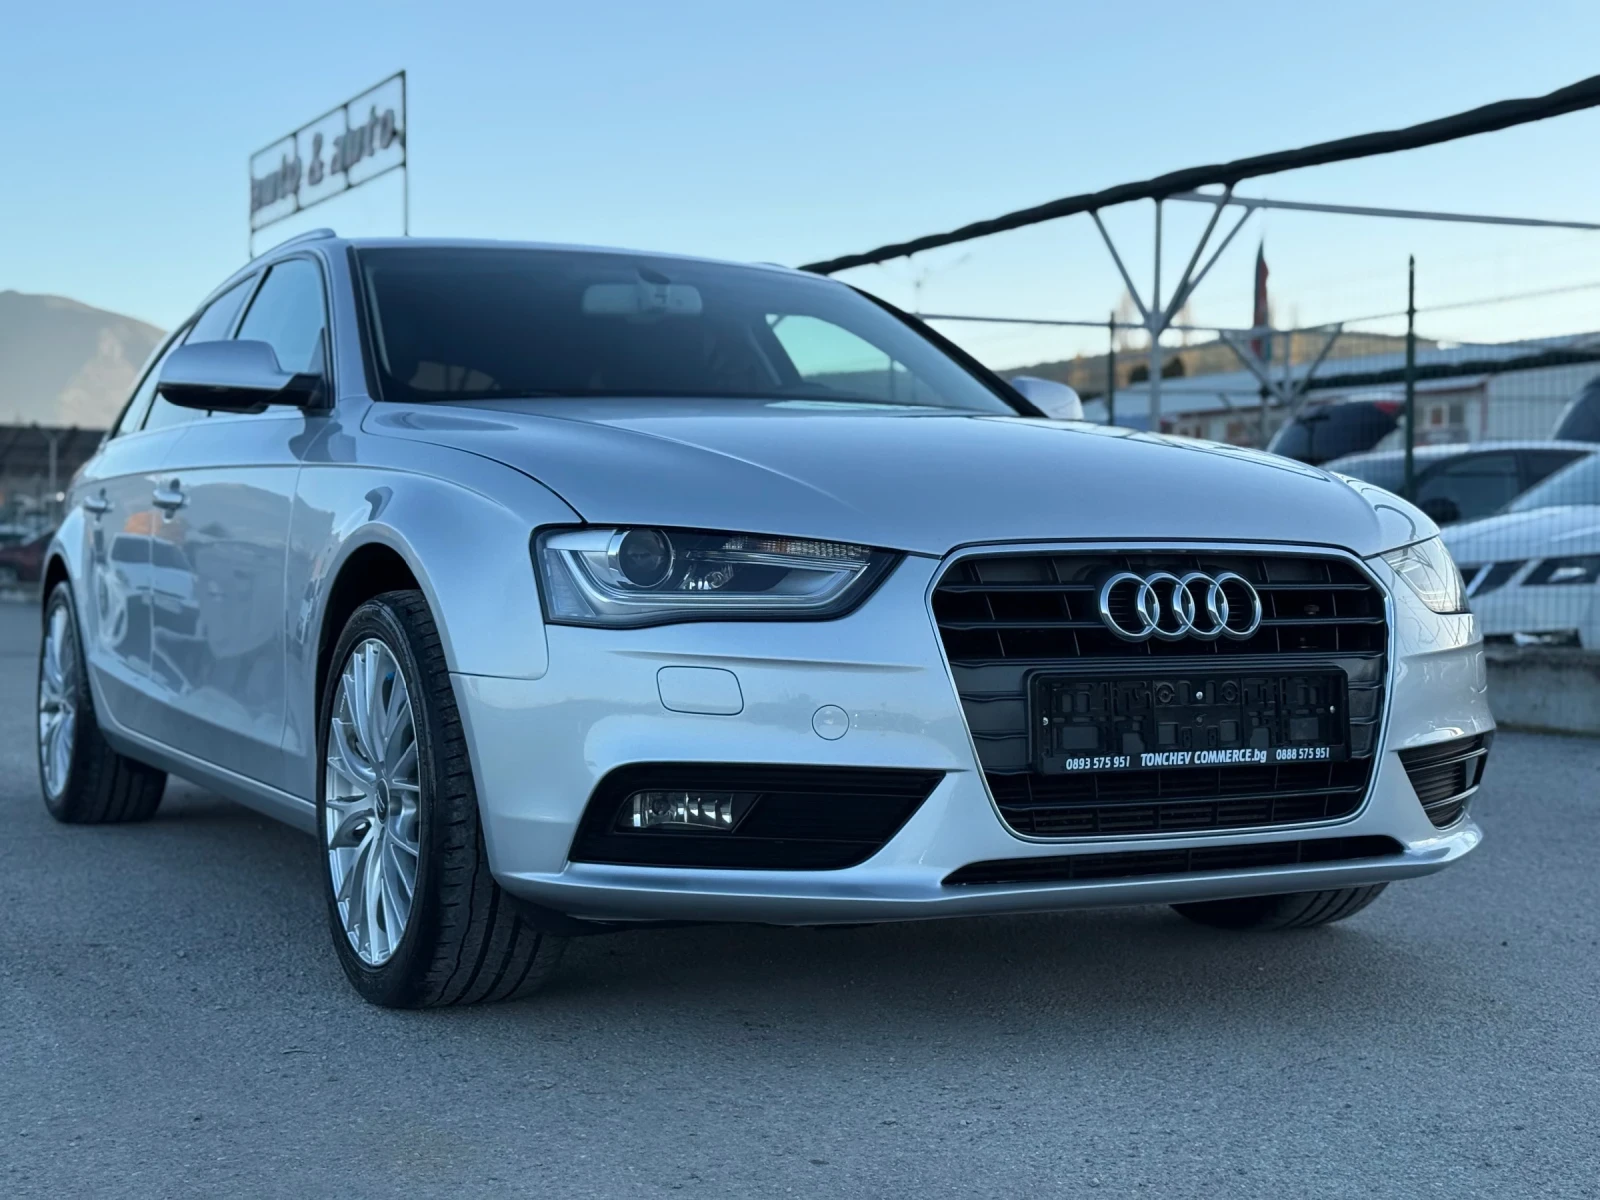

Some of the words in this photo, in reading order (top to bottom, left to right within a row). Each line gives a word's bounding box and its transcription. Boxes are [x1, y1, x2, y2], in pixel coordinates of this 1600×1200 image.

[1066, 758, 1091, 770] 0893
[1093, 757, 1111, 768] 575
[1113, 756, 1130, 768] 951
[1141, 752, 1192, 767] TONCHEV
[1194, 749, 1267, 764] COMMERCE.bg
[1276, 749, 1297, 760] 0888
[1299, 748, 1314, 759] 575
[1316, 747, 1330, 758] 951
